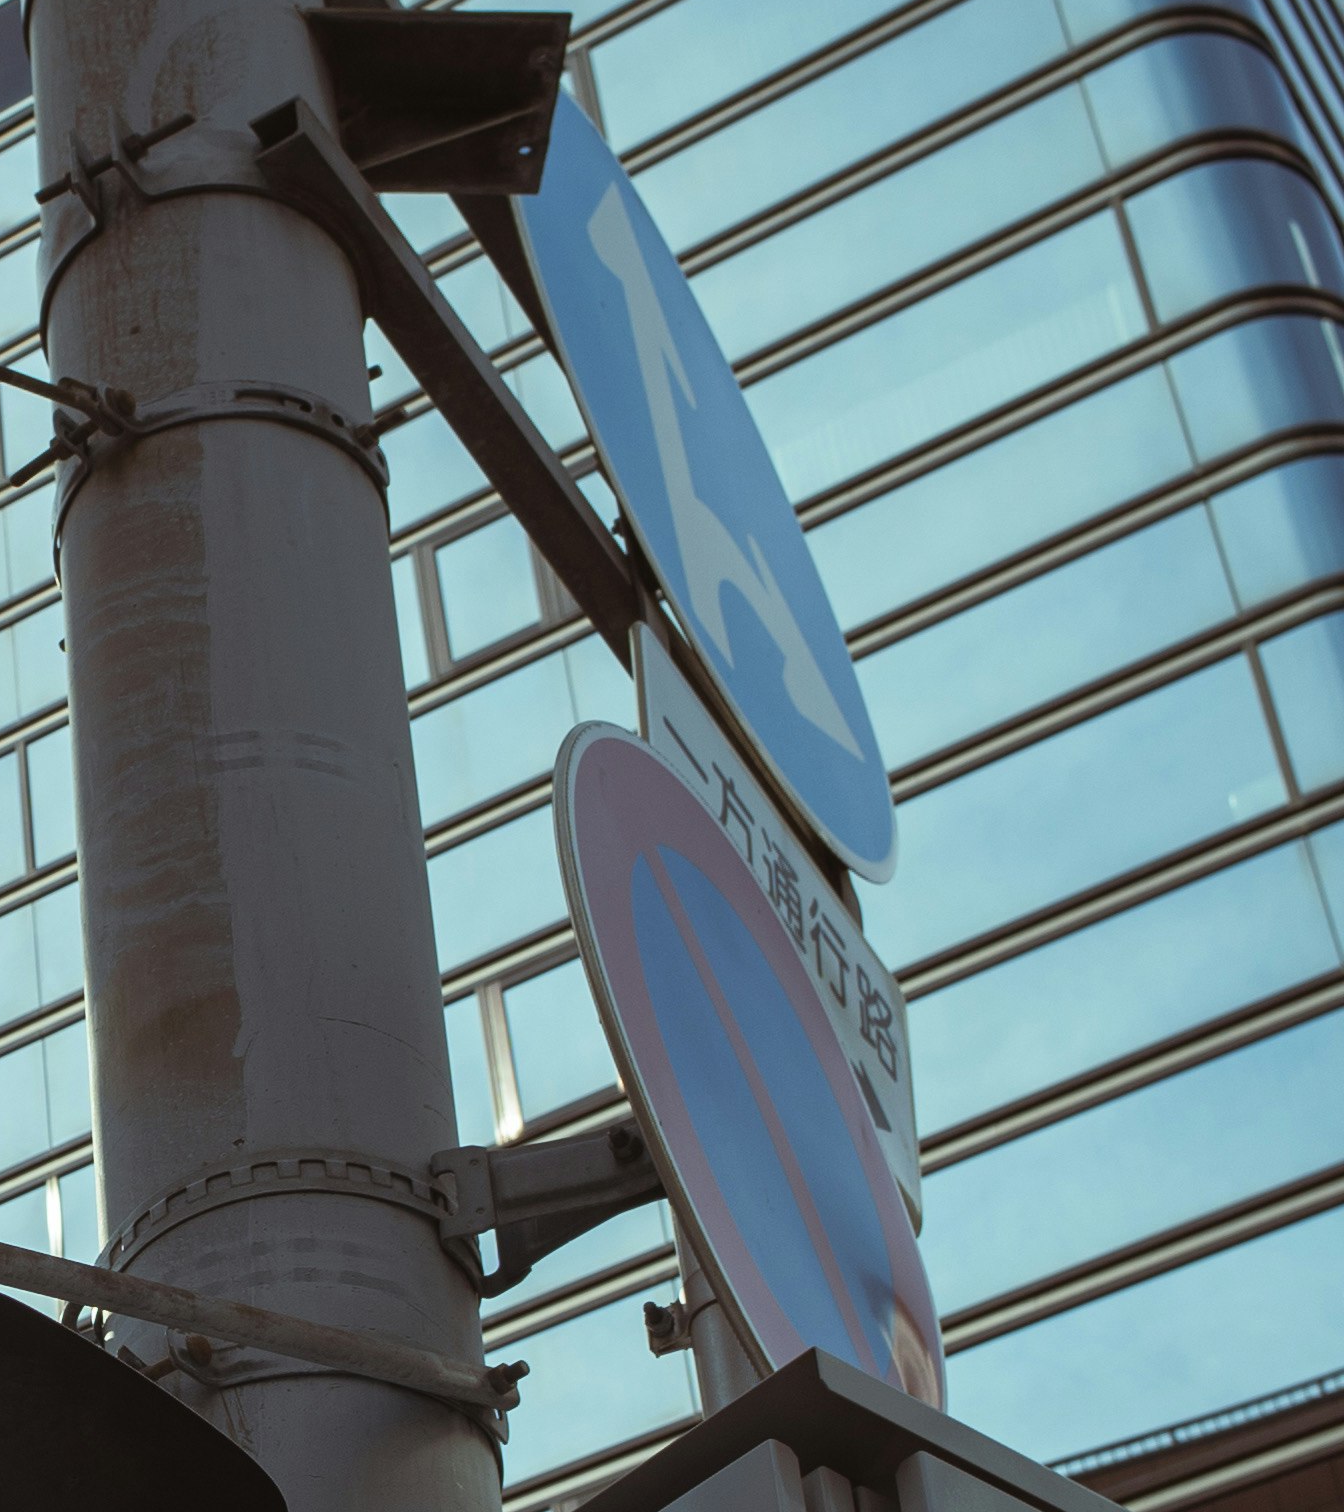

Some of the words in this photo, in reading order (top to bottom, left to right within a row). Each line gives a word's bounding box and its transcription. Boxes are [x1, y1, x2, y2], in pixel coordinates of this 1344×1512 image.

[661, 714, 898, 1084] 一方通行路
